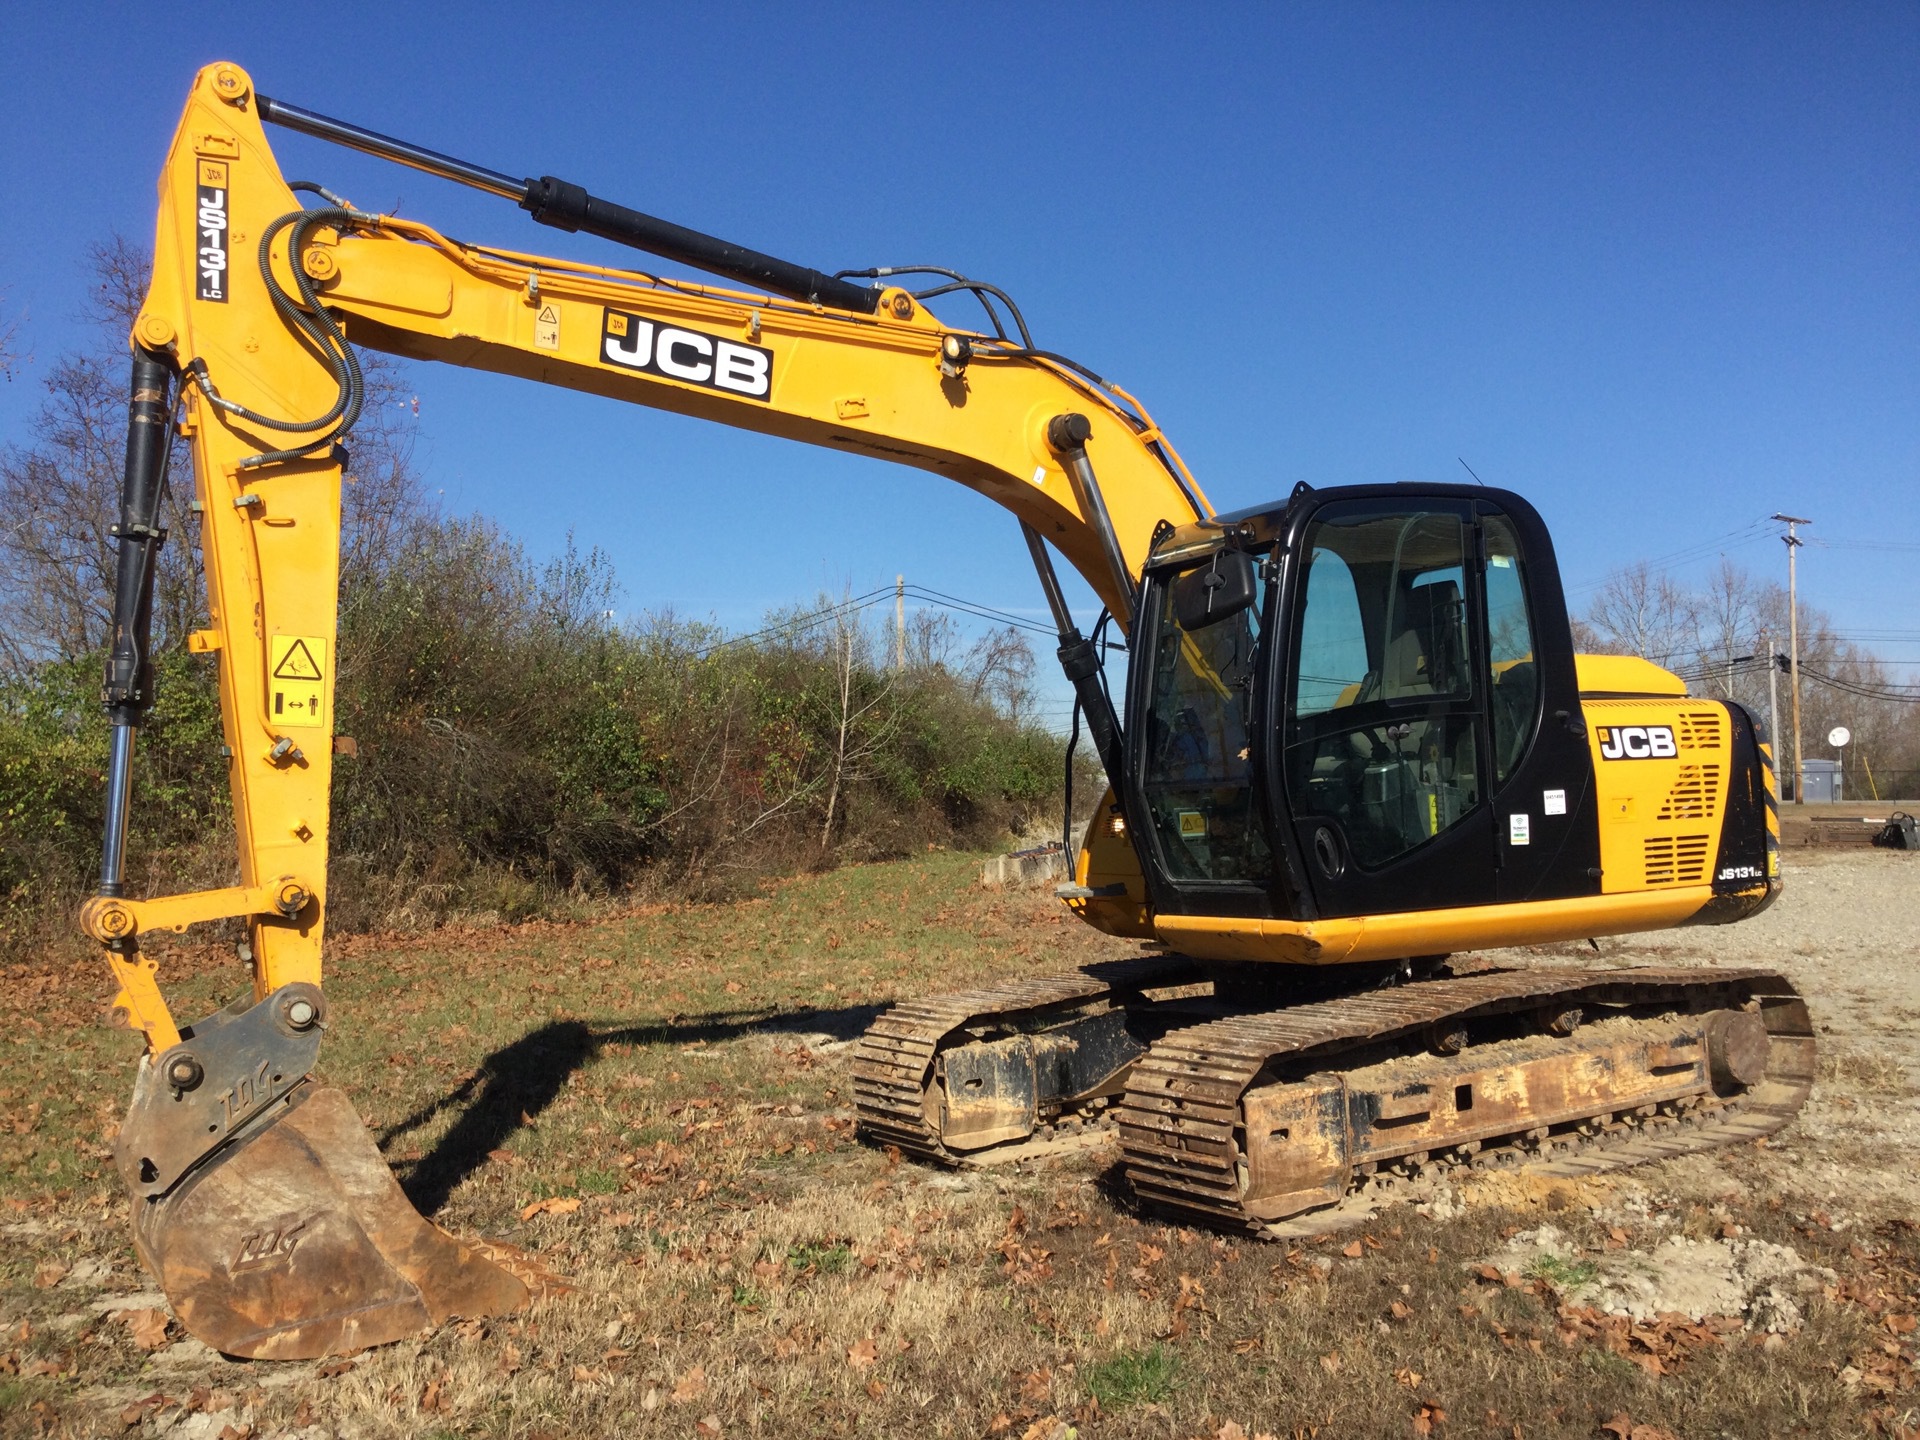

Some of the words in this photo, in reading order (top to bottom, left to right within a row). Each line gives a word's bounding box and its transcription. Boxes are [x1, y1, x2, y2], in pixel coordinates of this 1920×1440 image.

[206, 168, 223, 181] JCB
[199, 190, 227, 289] JS131
[203, 289, 222, 299] LC
[605, 320, 769, 396] JCB
[1601, 727, 1676, 759] JCB
[1718, 866, 1754, 880] JS131
